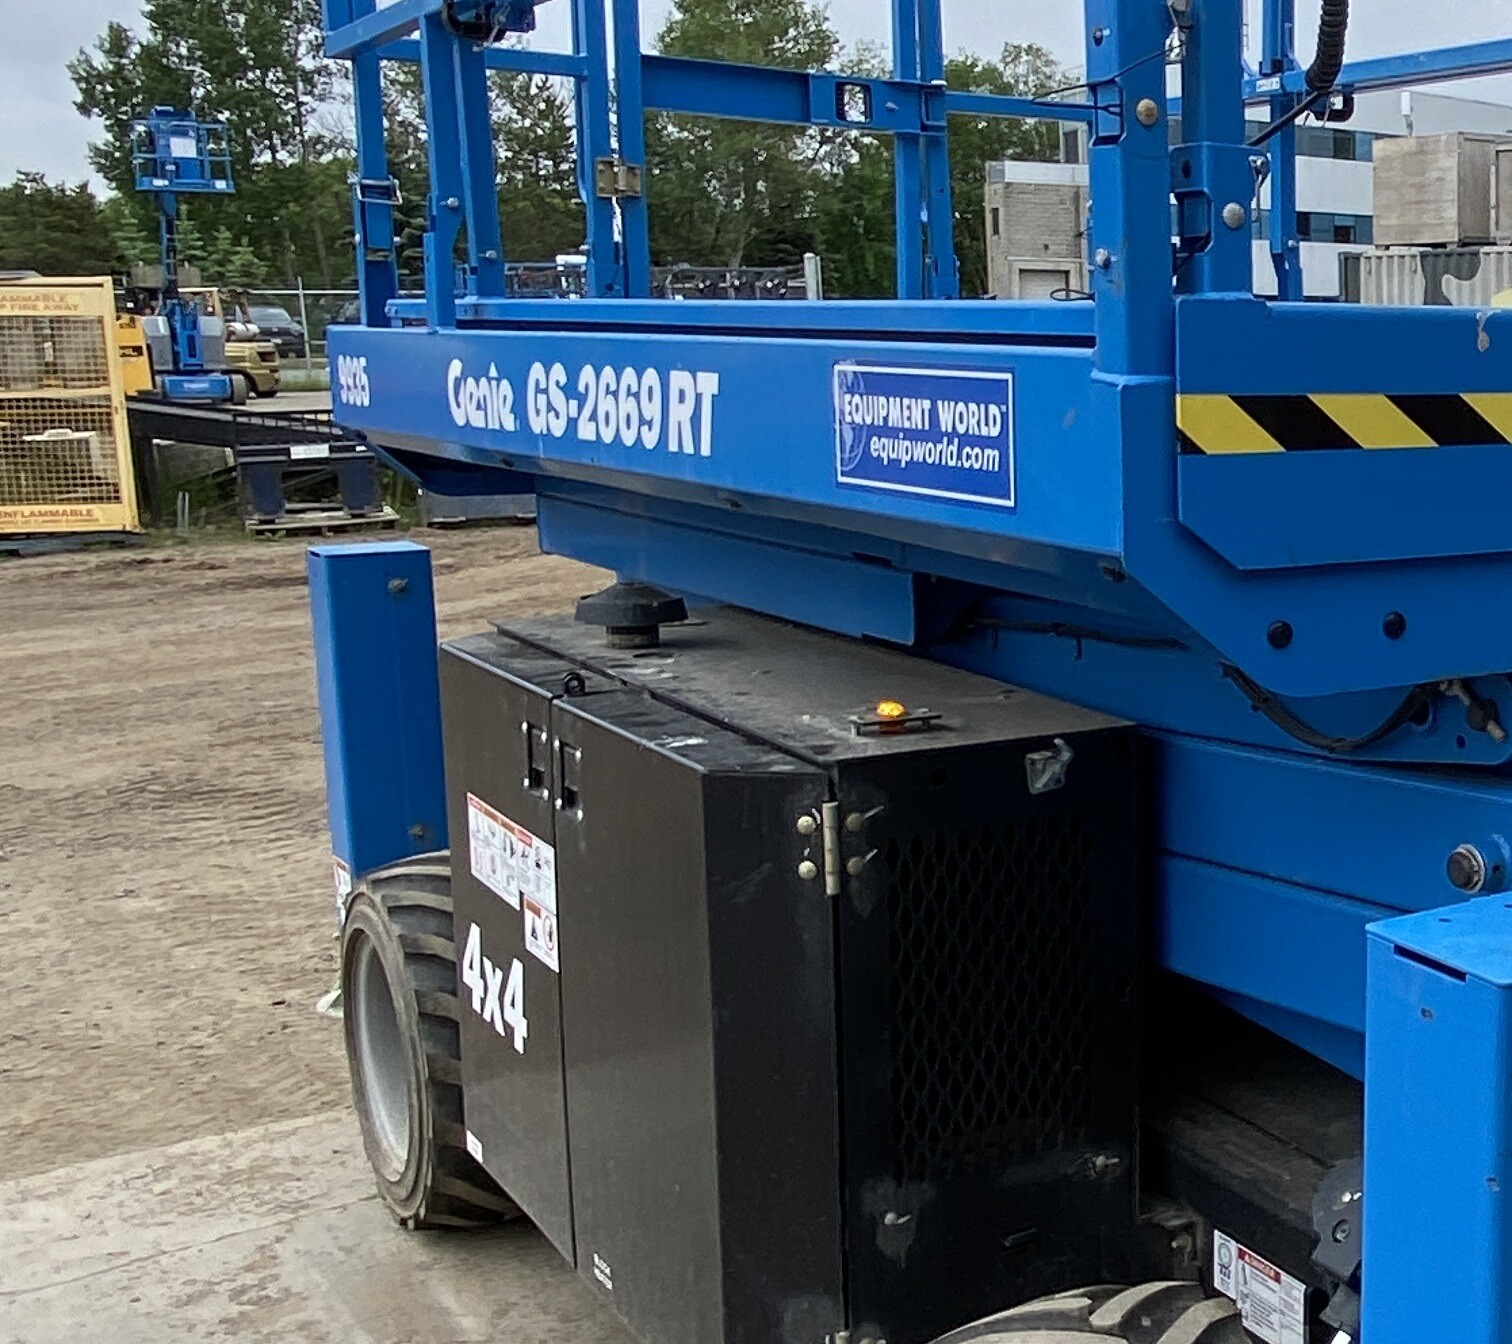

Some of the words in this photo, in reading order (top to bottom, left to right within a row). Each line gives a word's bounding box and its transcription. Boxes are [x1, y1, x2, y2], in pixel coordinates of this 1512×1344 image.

[337, 353, 371, 408] 9935
[447, 358, 515, 432] Genie
[526, 361, 663, 451] GS-2669
[668, 370, 720, 458] RT
[843, 393, 932, 431] EQUIPMENT
[936, 400, 1003, 438] WORLD
[869, 431, 1000, 473] equipworld.com
[461, 921, 530, 1055] 4x4
